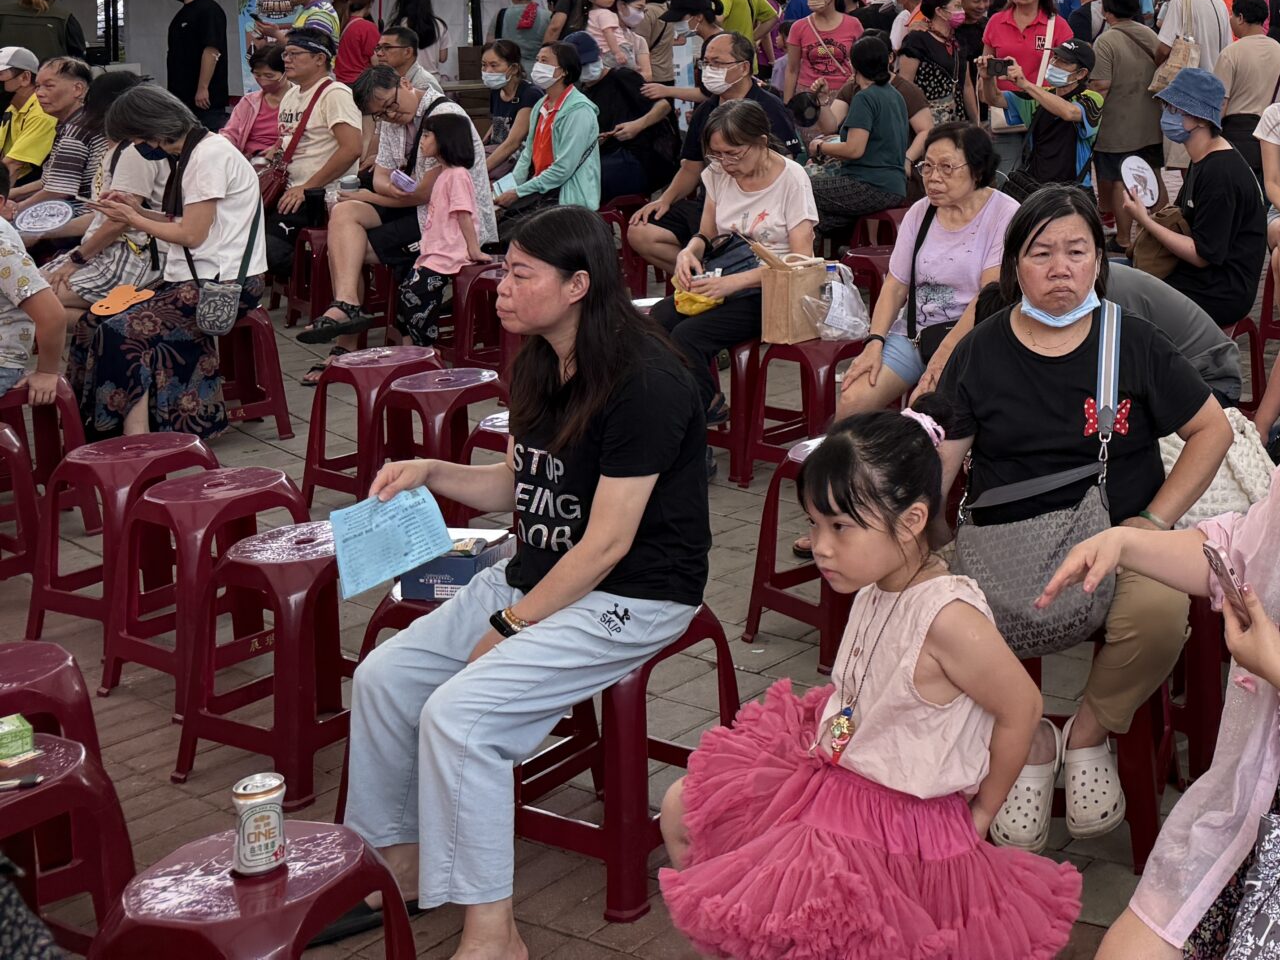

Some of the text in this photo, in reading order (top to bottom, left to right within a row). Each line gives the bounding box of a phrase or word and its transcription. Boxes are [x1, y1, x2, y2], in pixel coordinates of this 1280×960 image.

[513, 443, 564, 484] STOP
[515, 482, 581, 519] EING
[517, 518, 574, 552] OOR
[600, 613, 622, 634] SKIP
[247, 826, 278, 844] ONE
